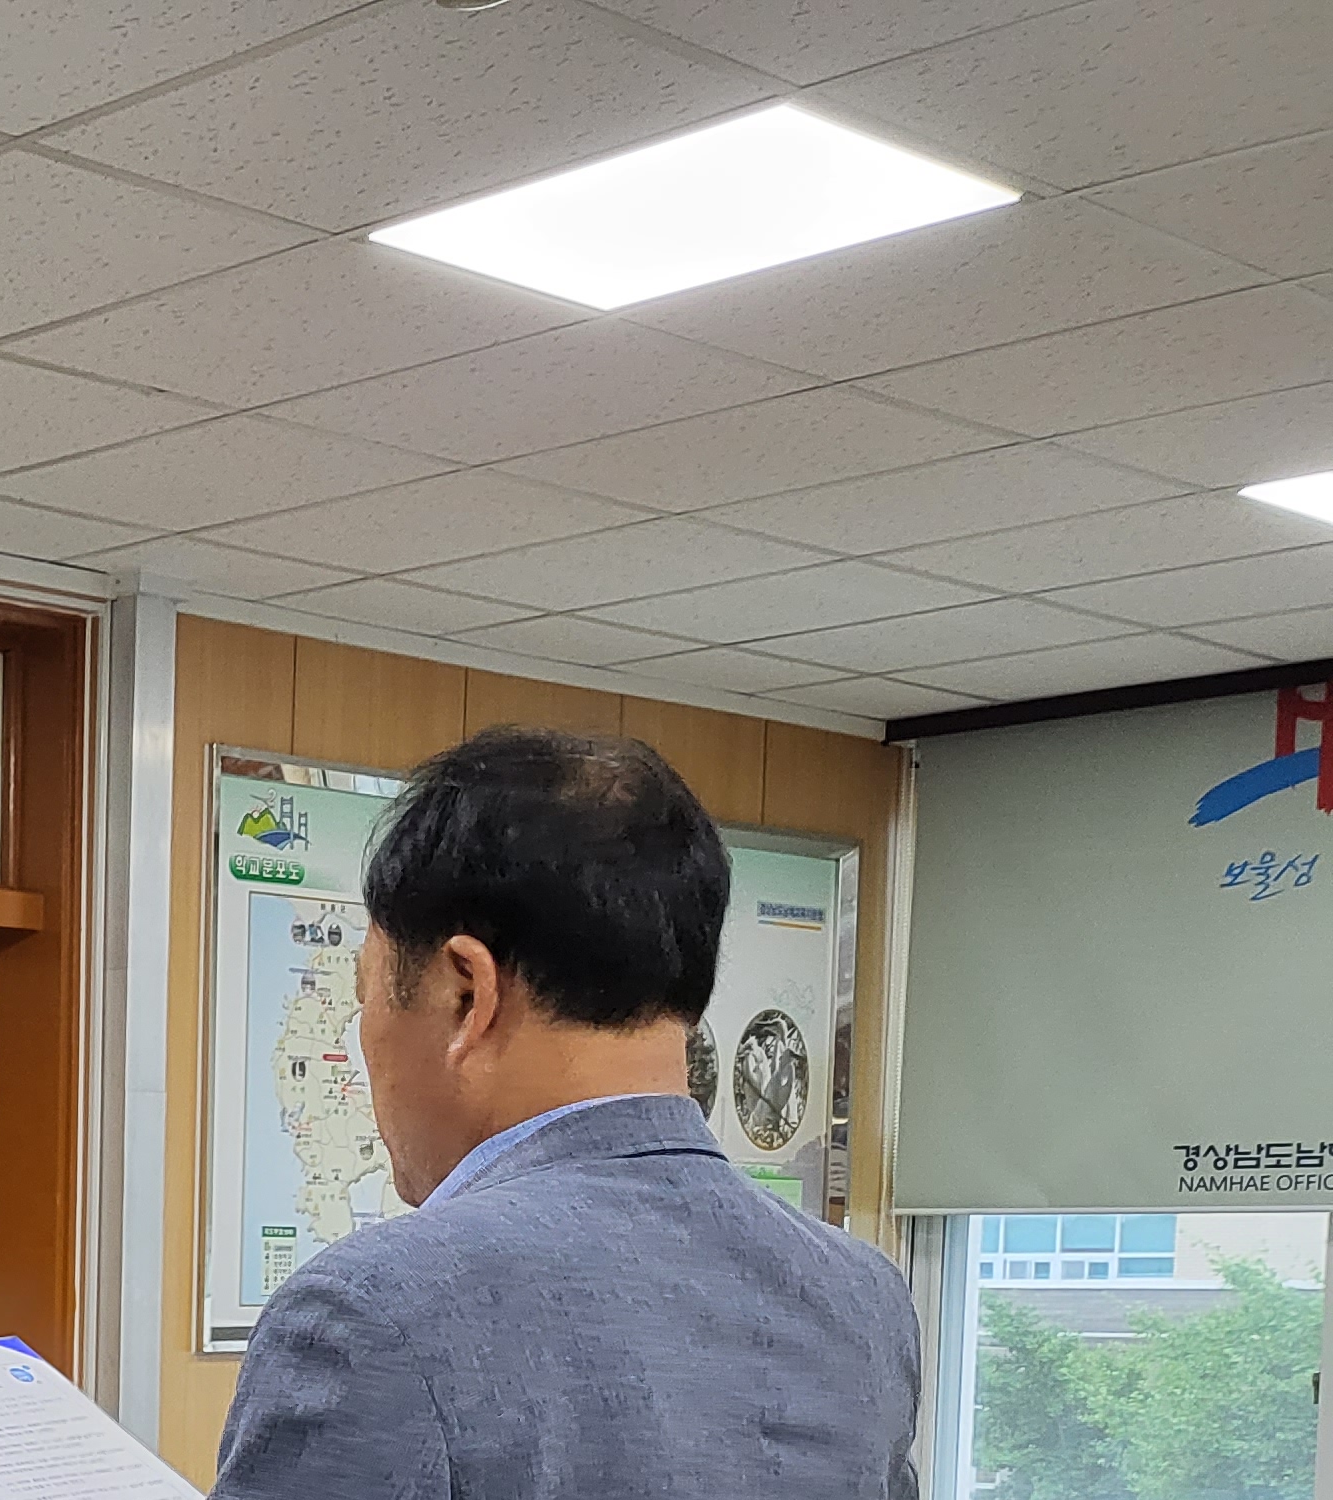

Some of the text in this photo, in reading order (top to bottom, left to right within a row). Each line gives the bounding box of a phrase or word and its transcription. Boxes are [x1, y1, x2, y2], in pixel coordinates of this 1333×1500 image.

[235, 855, 300, 880] 학교분포도
[1219, 850, 1321, 902] 보물섬
[1173, 1141, 1333, 1171] 경상남도남
[1179, 1174, 1271, 1192] NAMHAE
